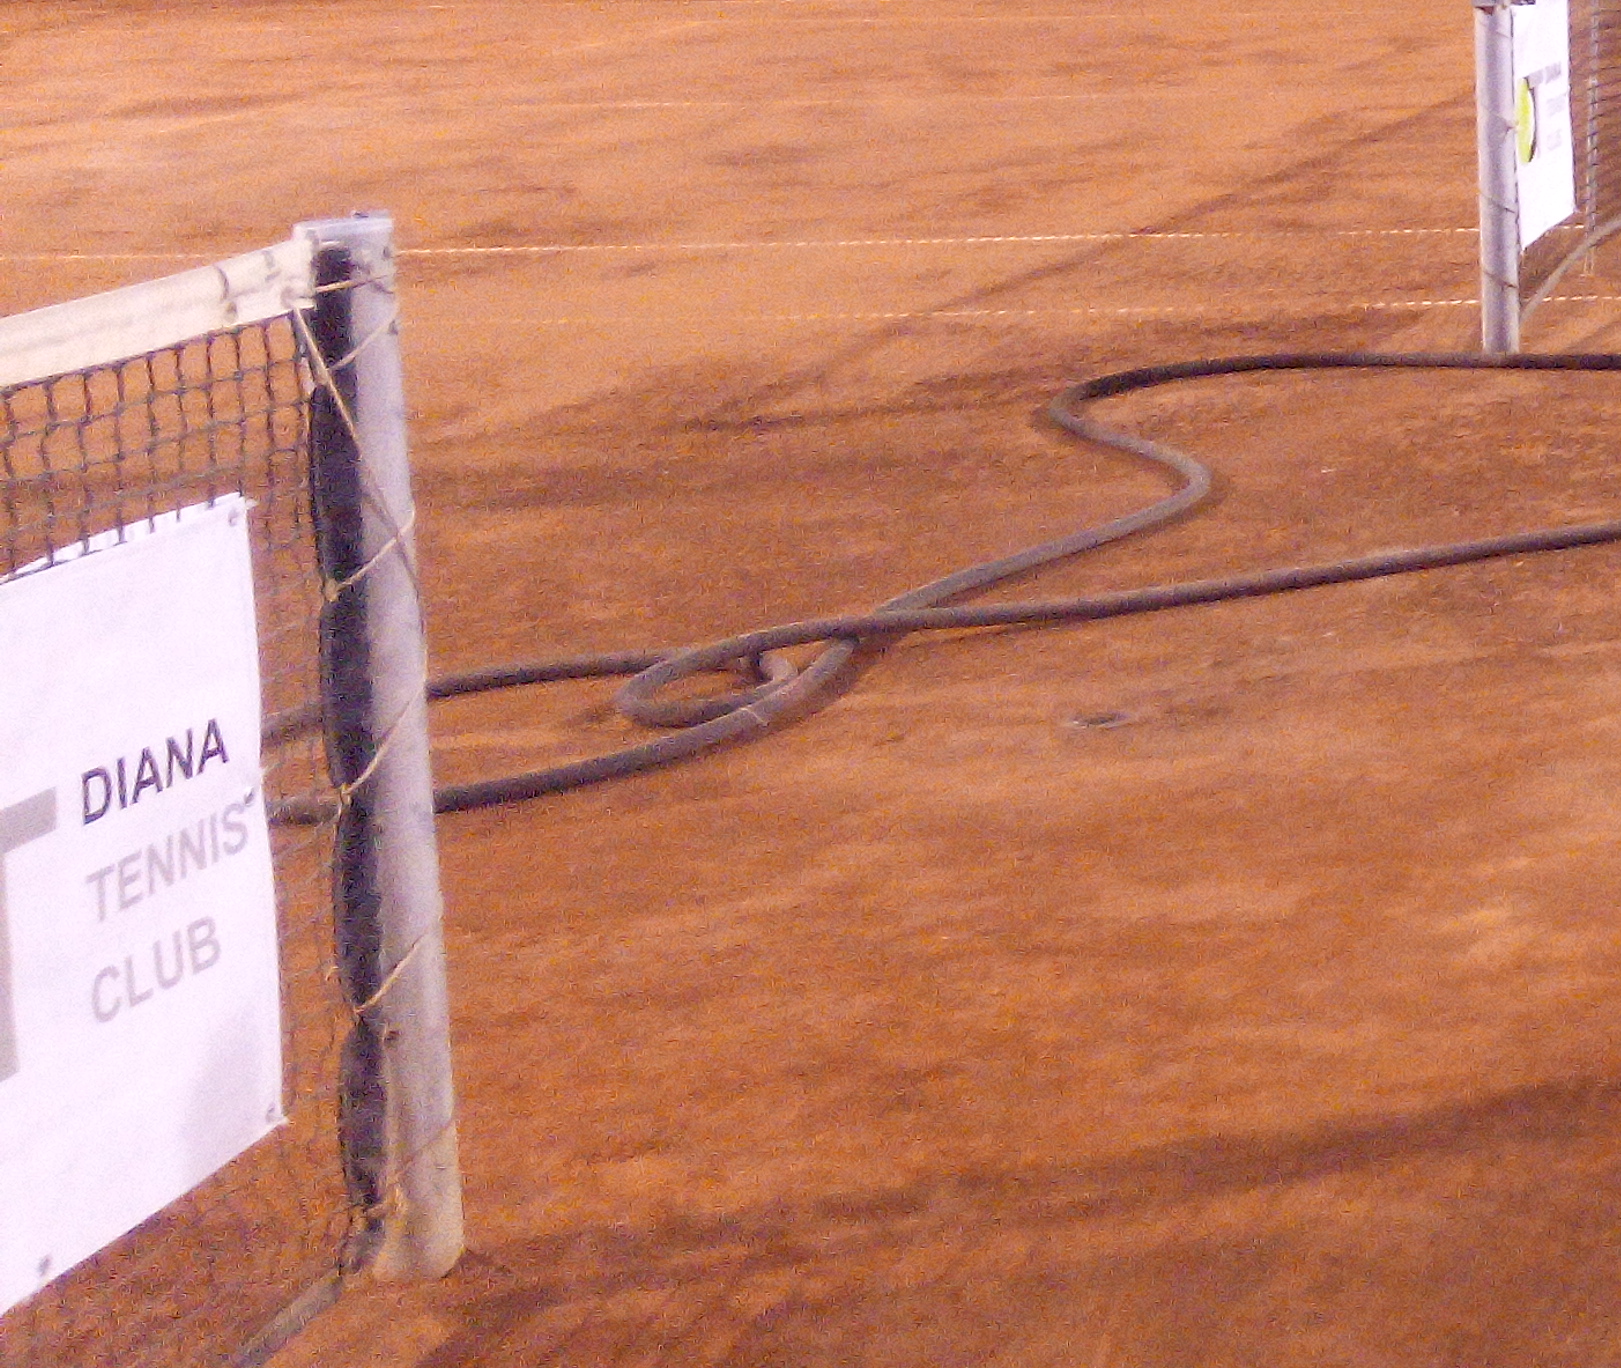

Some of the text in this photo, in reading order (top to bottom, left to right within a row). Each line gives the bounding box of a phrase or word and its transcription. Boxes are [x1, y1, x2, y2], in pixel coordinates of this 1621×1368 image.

[80, 717, 229, 826] DIANA
[85, 801, 250, 923] TENNIS
[90, 915, 223, 1024] CLUB
